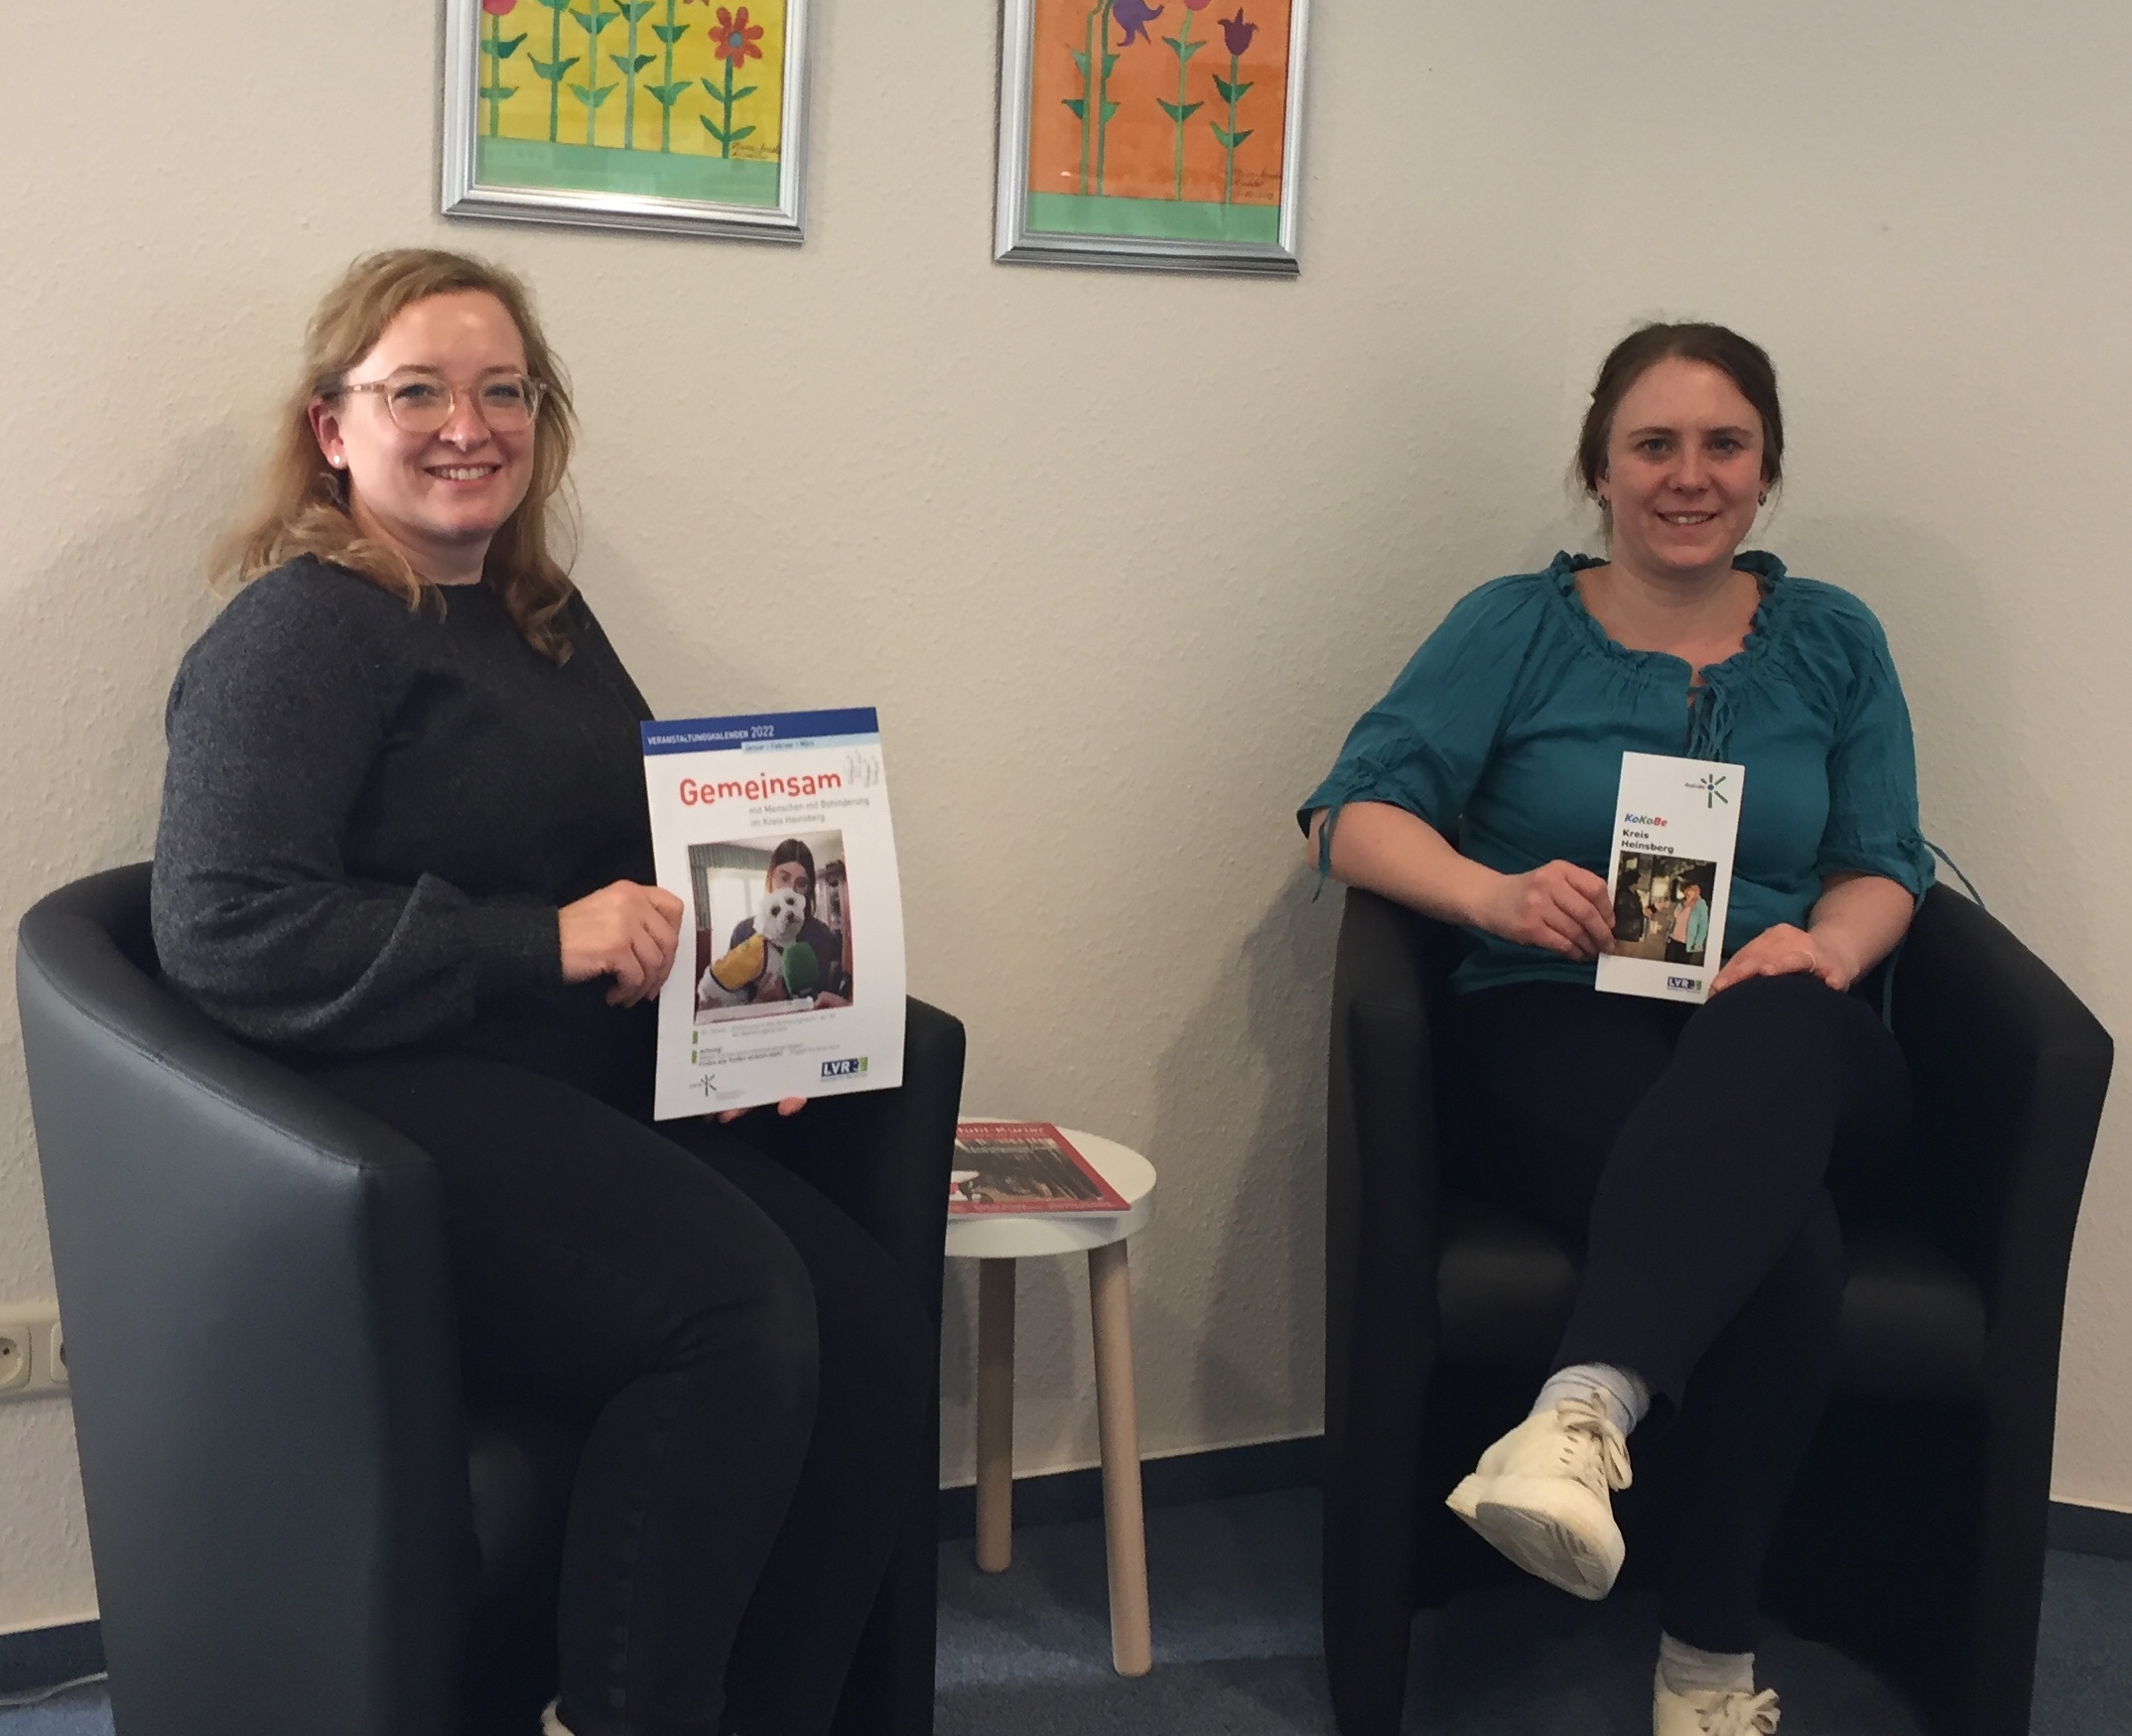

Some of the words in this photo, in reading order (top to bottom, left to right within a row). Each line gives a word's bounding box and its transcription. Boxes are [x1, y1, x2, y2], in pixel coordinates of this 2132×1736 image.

[647, 730, 748, 745] VERANSTALTUNGSKALENDER
[750, 726, 775, 737] 2022
[679, 772, 842, 806] Gemeinsam
[764, 804, 805, 814] Menschen
[821, 797, 869, 809] Behinderung
[785, 813, 826, 824] Heinsberg
[1624, 813, 1667, 827] KoKoBe
[1622, 829, 1650, 839] Kreis
[1621, 840, 1674, 855] Heinsberg
[1668, 978, 1689, 989] LVR
[824, 1061, 851, 1076] LVR
